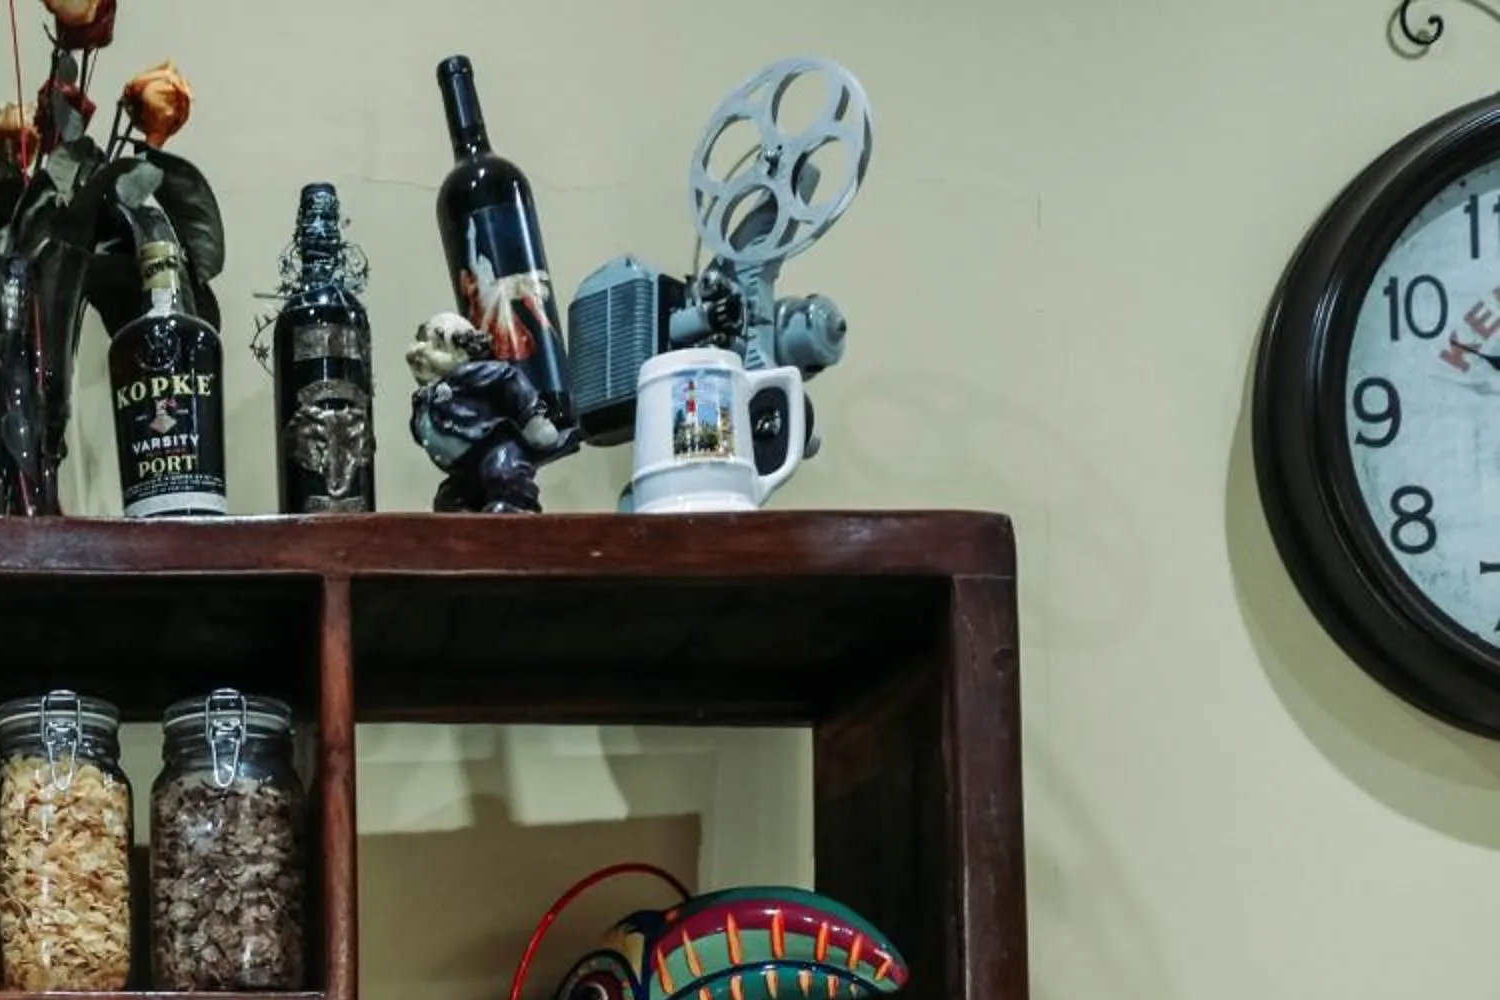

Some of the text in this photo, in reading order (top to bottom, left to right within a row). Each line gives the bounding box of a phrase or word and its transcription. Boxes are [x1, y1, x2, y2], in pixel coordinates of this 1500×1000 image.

[1383, 274, 1448, 342] 10
[1438, 285, 1500, 374] KE
[116, 374, 212, 409] KOPKE
[1353, 377, 1402, 448] 9
[132, 433, 199, 454] VARSITY
[139, 454, 196, 478] PORT
[1390, 485, 1437, 555] 8
